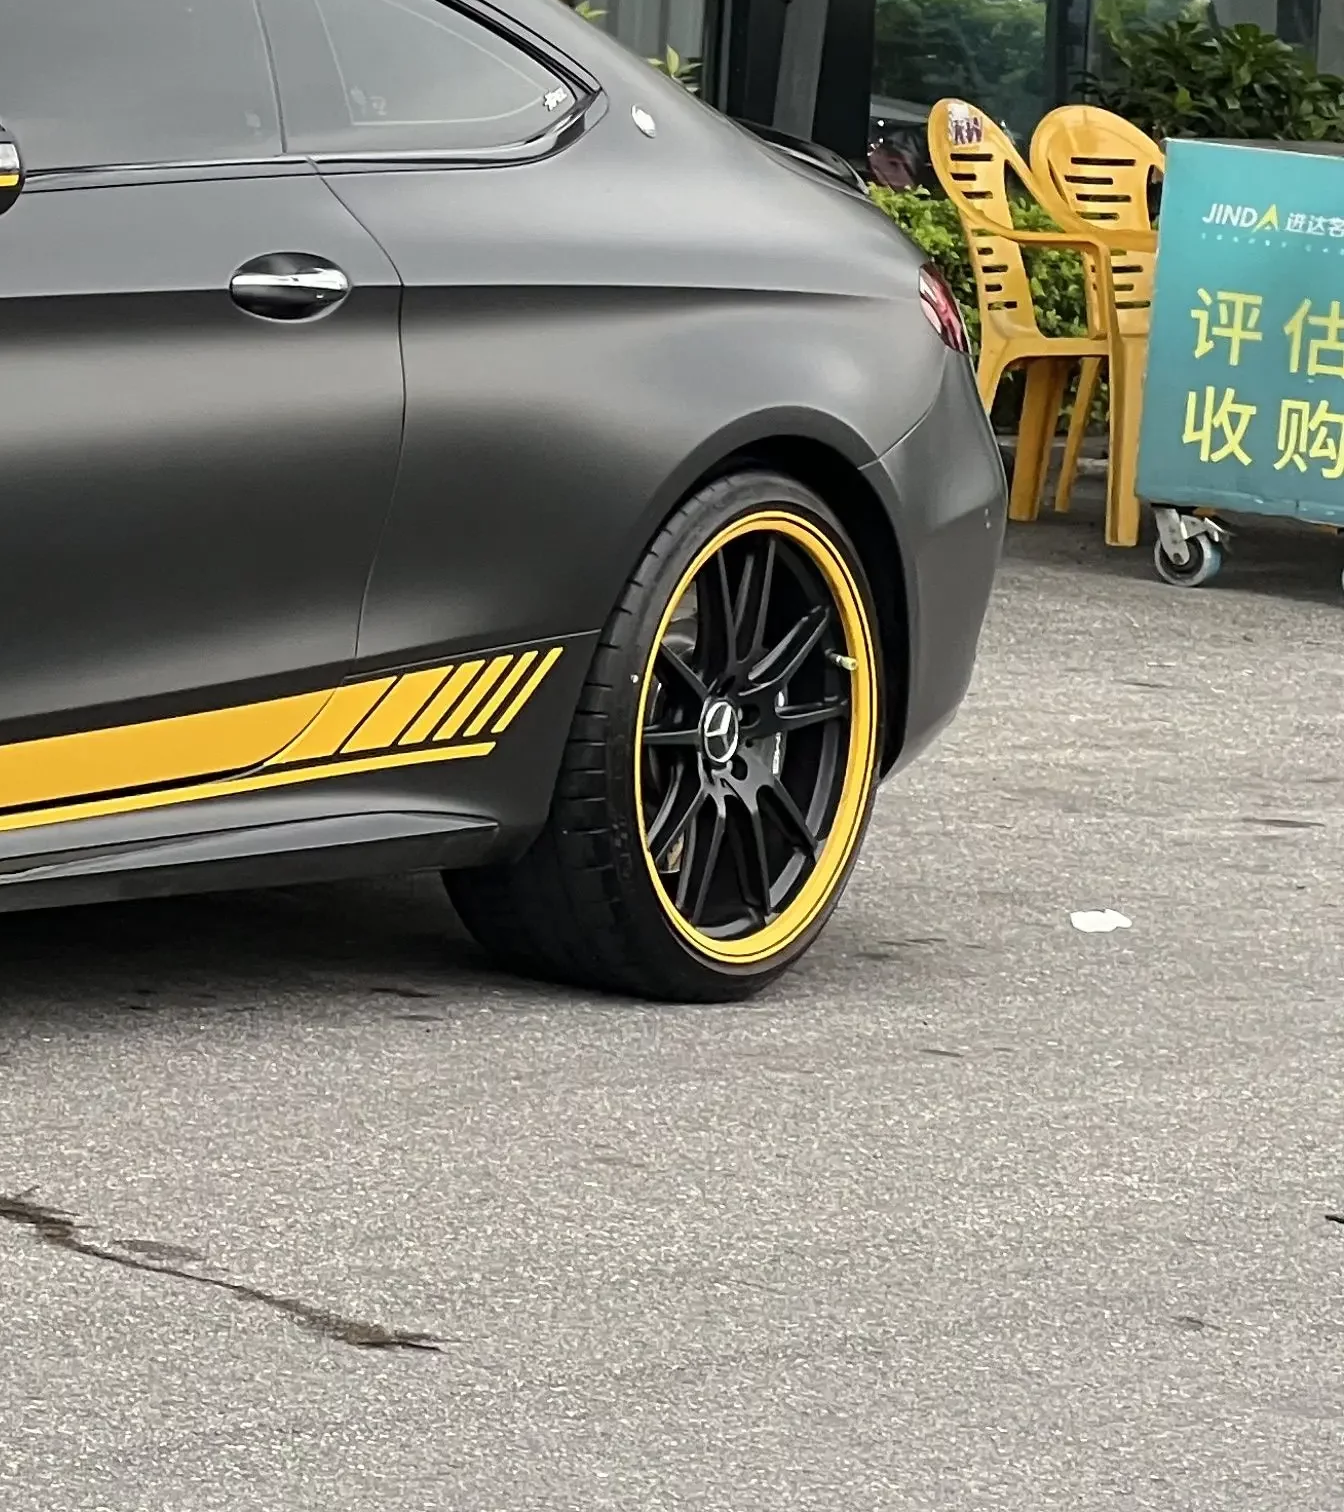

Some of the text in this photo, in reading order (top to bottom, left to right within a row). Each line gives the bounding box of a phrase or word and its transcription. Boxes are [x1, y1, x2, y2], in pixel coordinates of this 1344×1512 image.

[1201, 203, 1279, 234] JINDA
[1191, 287, 1344, 379] 评估
[1182, 385, 1344, 479] 收购
